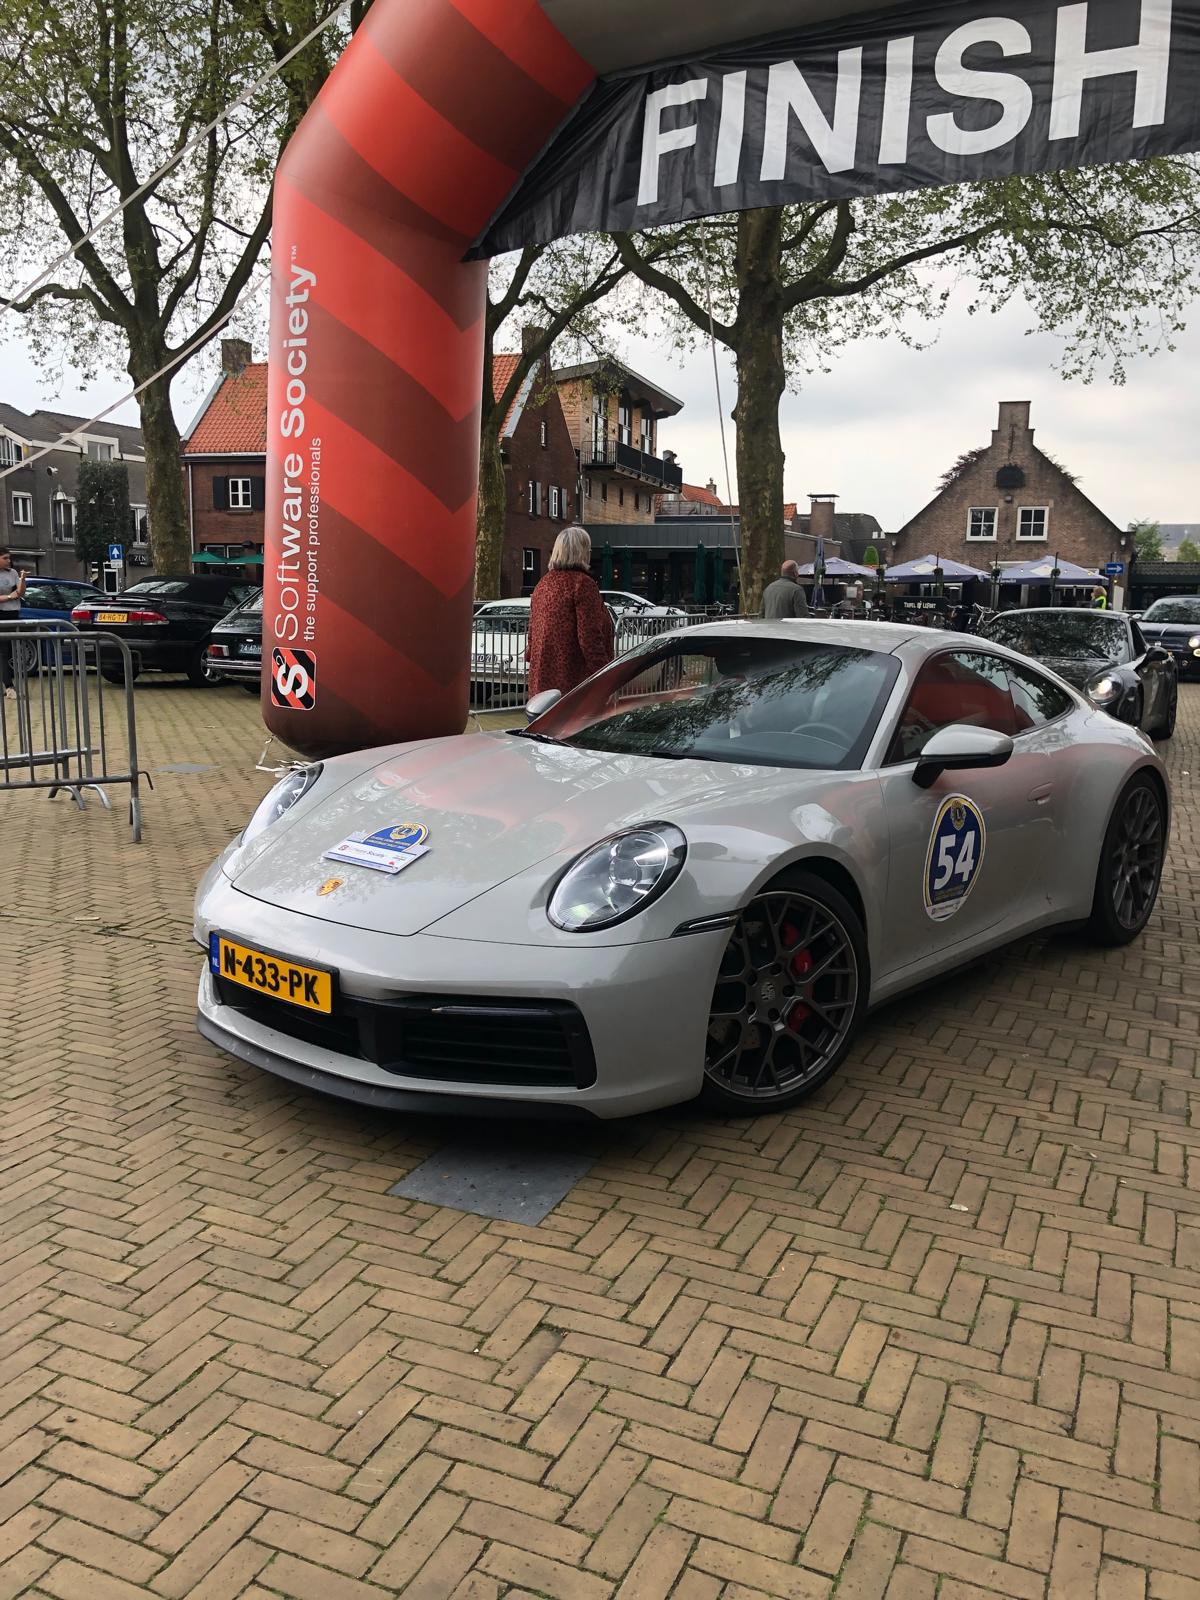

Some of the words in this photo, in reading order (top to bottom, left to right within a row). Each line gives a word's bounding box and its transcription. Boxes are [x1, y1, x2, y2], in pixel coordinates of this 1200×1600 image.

[636, 0, 1173, 206] FINISH
[280, 264, 317, 438] Society
[308, 437, 322, 547] professionals
[275, 453, 304, 641] Software
[307, 549, 320, 612] support
[304, 614, 315, 642] the
[934, 830, 976, 890] 54
[212, 956, 220, 968] NL
[223, 945, 320, 1005] N-433-PK
